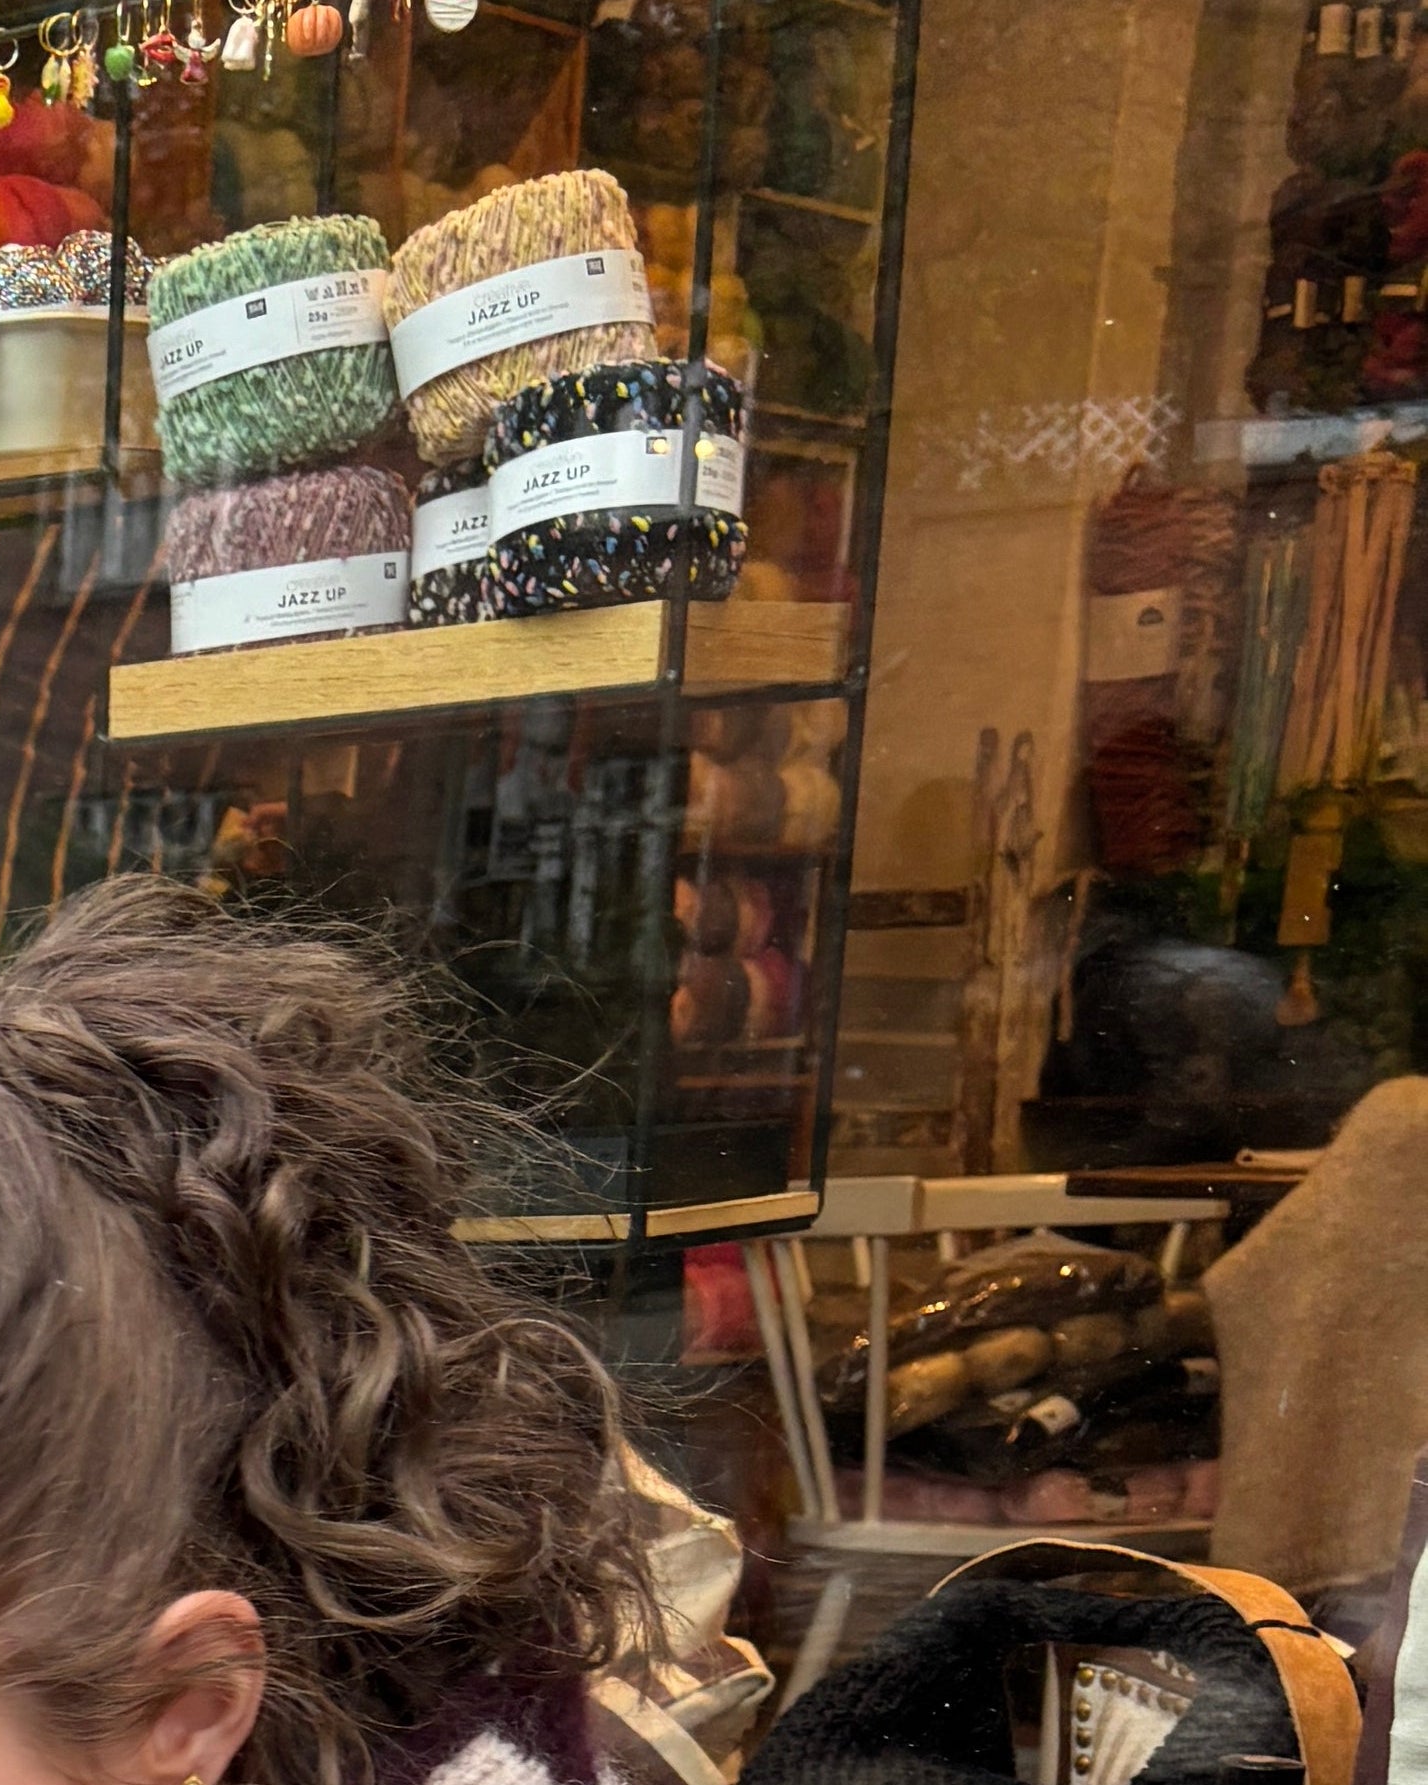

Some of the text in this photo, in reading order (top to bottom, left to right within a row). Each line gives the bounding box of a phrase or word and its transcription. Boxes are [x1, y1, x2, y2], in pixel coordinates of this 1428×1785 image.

[467, 300, 511, 327] JAZZ
[517, 290, 541, 310] UP
[160, 347, 183, 370] JAZZ
[186, 340, 204, 358] UP
[522, 464, 591, 494] JAZZ UP
[451, 514, 488, 535] JAZZ
[277, 587, 347, 608] JAZZ UP
